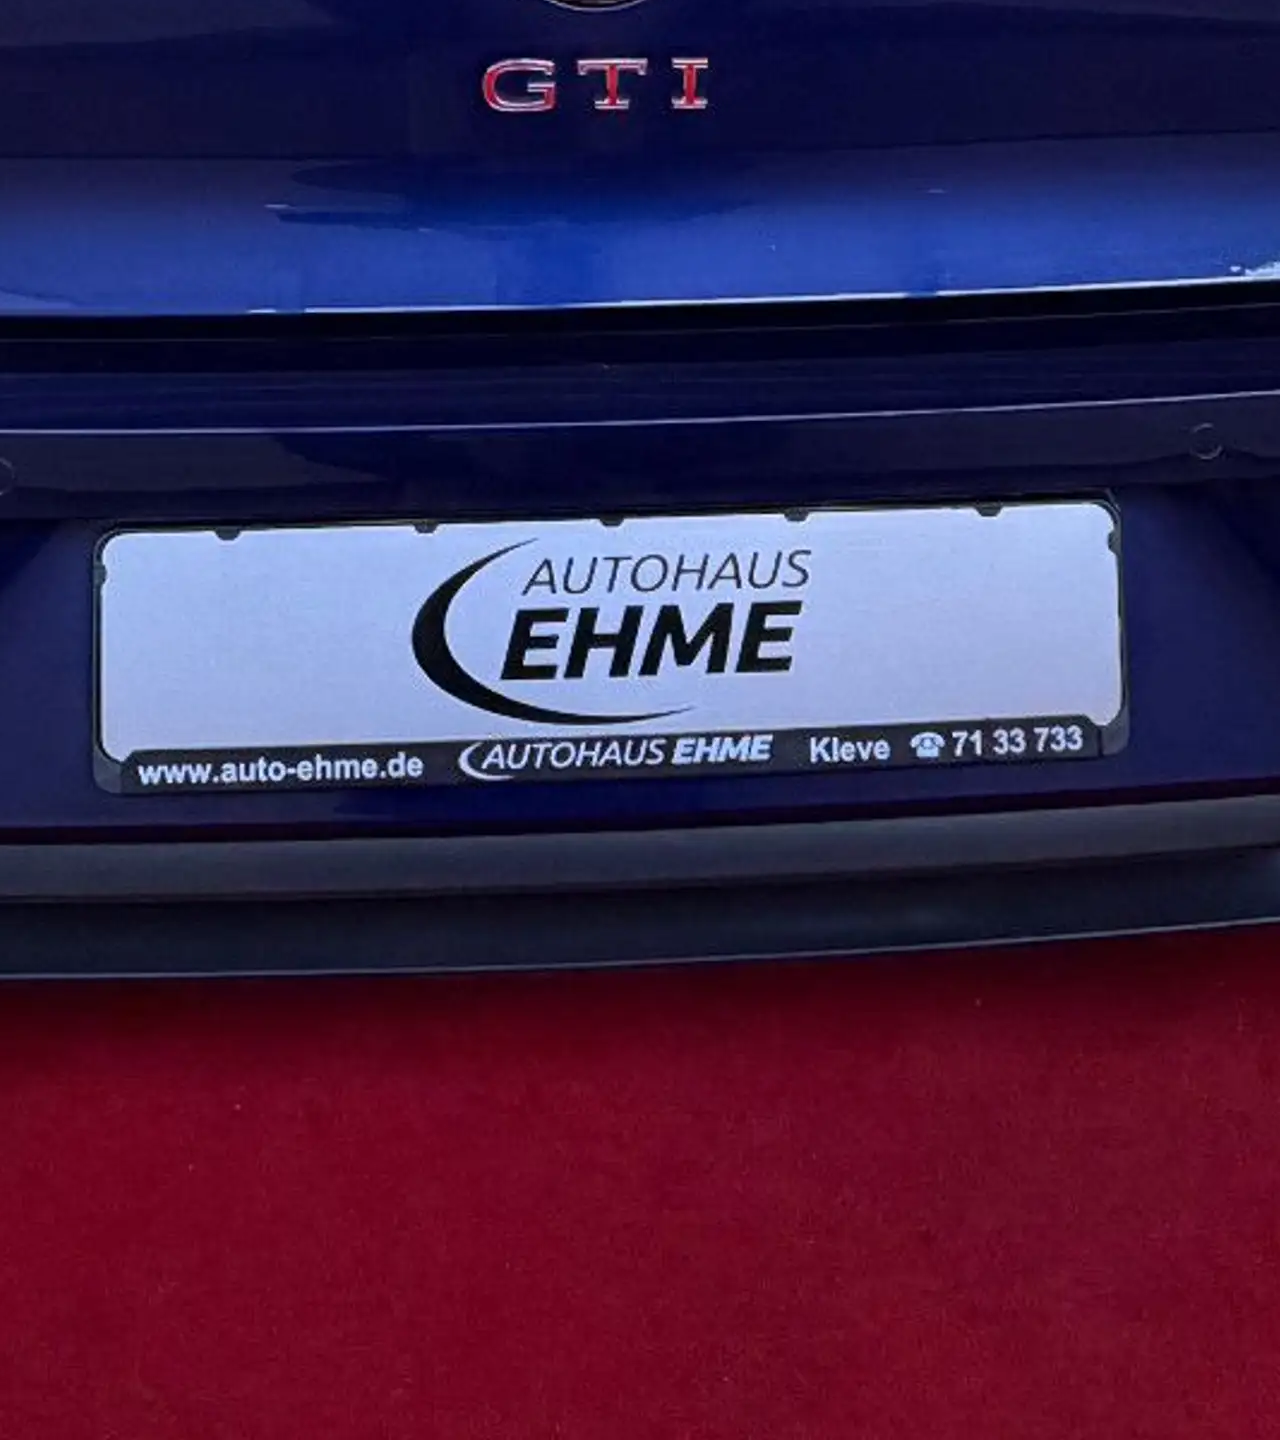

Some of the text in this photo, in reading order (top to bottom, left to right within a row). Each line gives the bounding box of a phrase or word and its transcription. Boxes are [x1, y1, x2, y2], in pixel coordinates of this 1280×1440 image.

[481, 57, 709, 112] GTI
[522, 549, 812, 598] AUTOHAUS
[499, 600, 803, 681] EHME
[137, 725, 1084, 786] www.auto-ehme.de AUTOHAUS EHME Kleve 71 33 733
